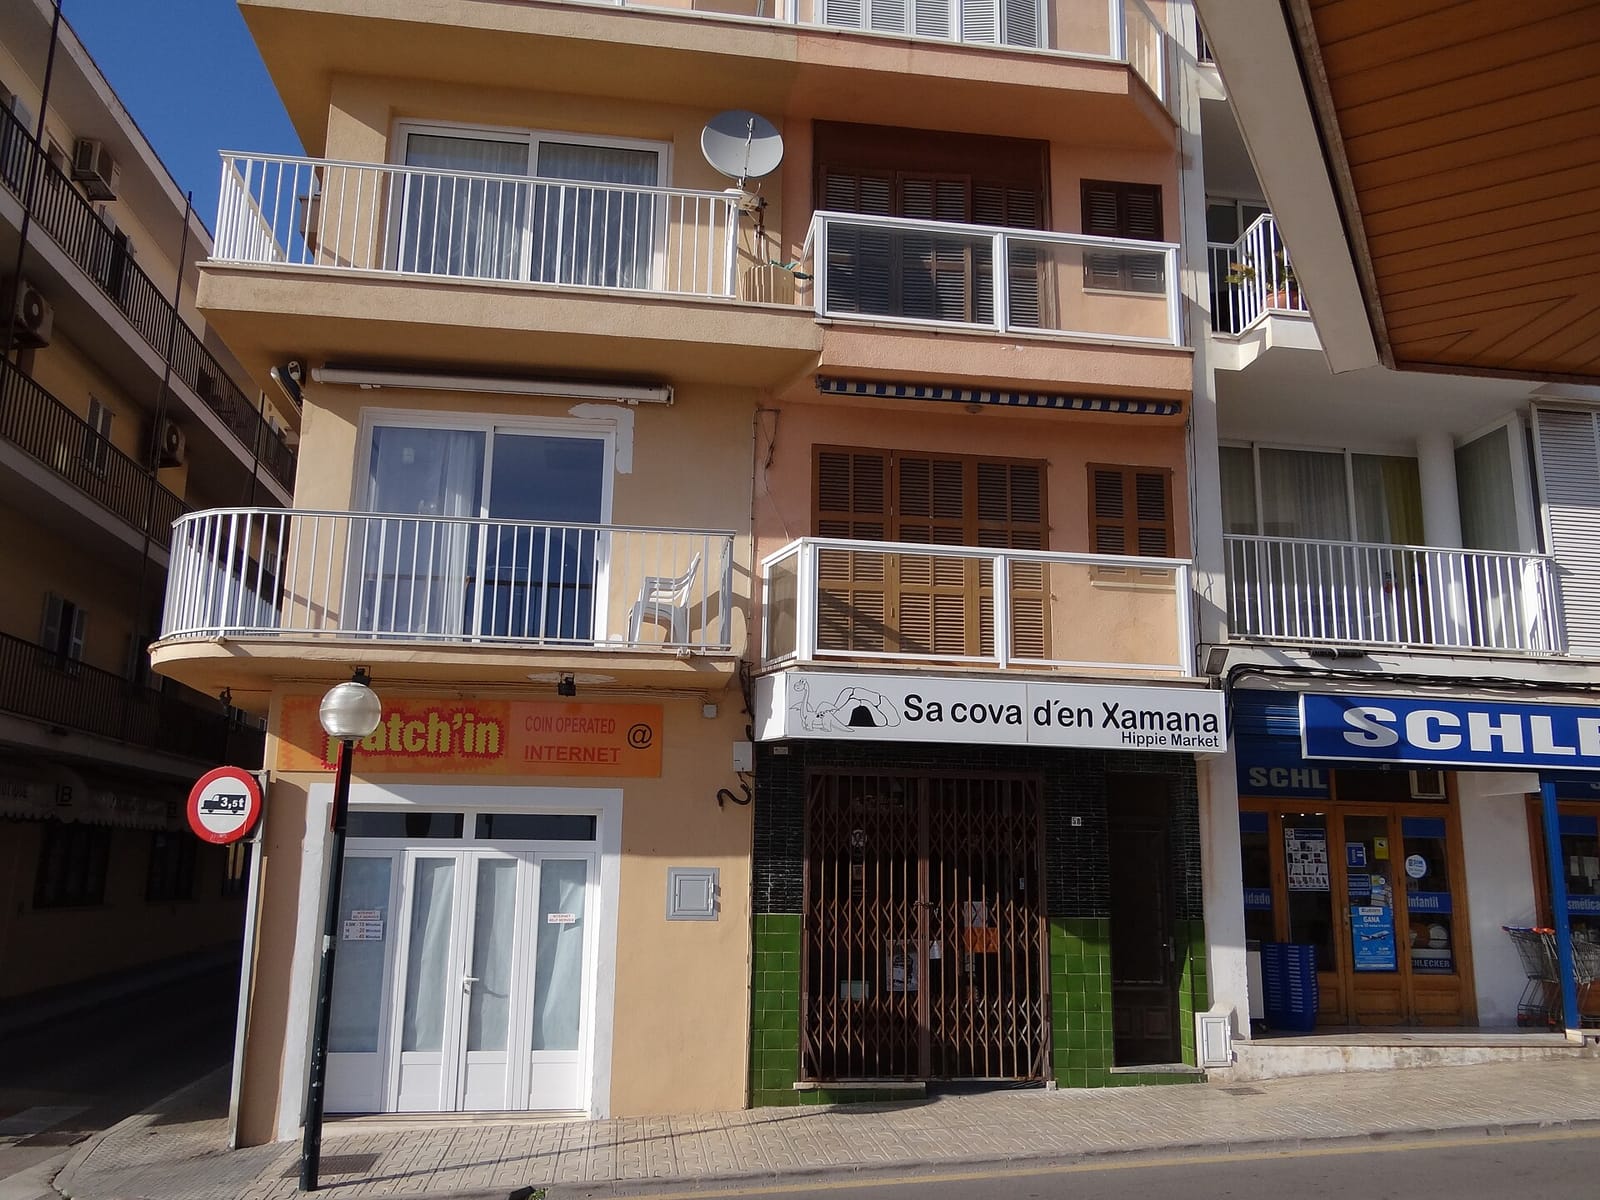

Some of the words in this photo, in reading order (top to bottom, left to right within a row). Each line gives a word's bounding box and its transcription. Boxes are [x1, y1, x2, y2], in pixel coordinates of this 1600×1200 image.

[903, 693, 943, 723] Sa
[950, 702, 1022, 725] cova
[1102, 702, 1218, 733] Xamana
[525, 715, 553, 733] COIN
[555, 717, 616, 735] OPERATED
[627, 723, 653, 750] @
[1121, 731, 1167, 747] Hippie
[1171, 733, 1219, 748] Market
[524, 744, 621, 763] INTERNET
[1249, 766, 1328, 790] SCHL
[220, 796, 245, 810] 3,5t
